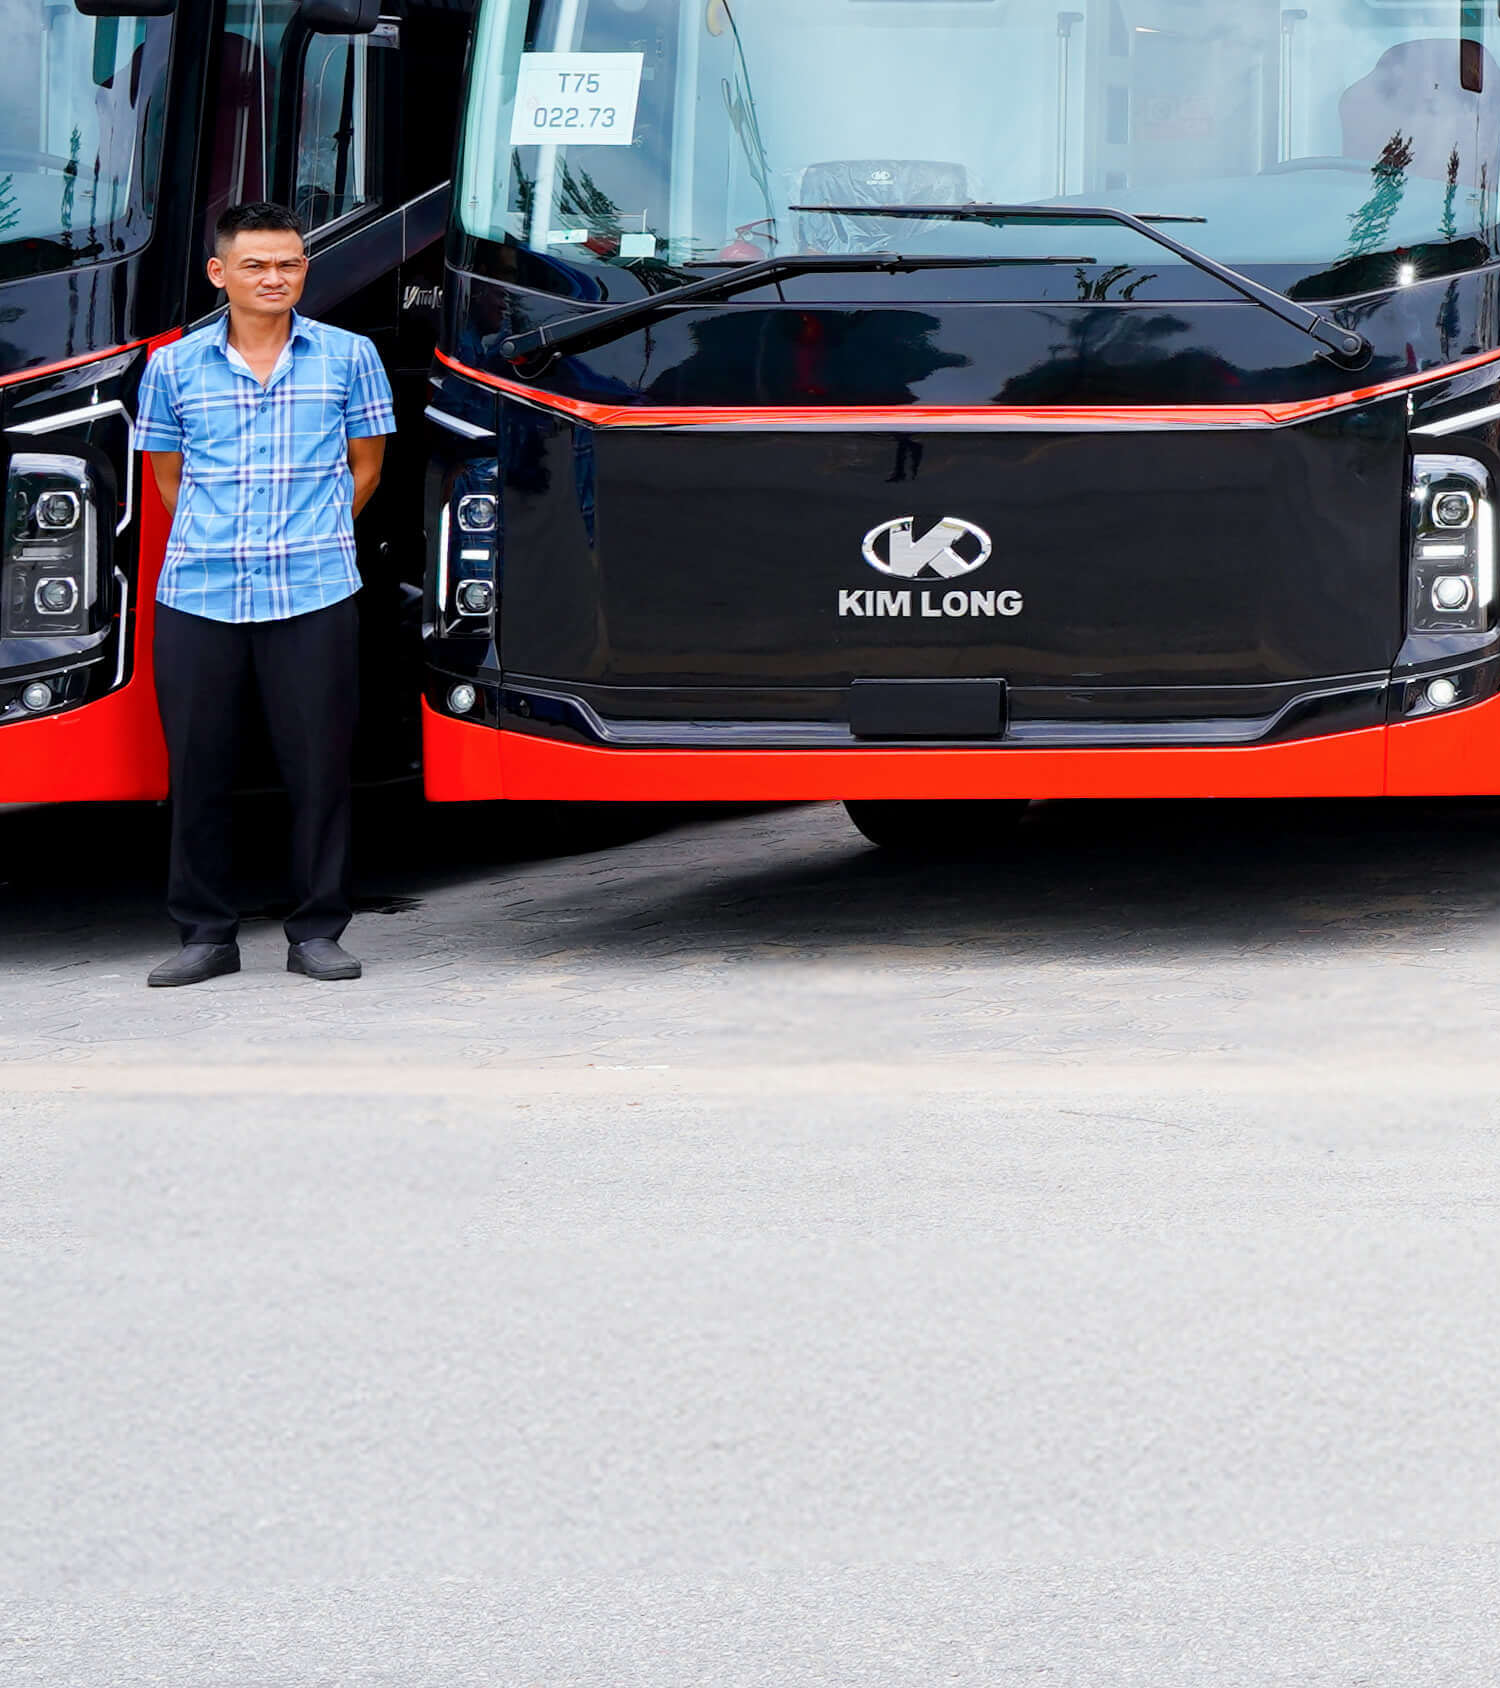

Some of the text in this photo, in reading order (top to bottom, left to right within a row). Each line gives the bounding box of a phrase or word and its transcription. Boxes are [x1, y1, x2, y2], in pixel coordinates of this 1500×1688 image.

[558, 73, 600, 93] T75
[533, 107, 616, 128] 022.73
[838, 589, 1023, 617] KIM LONG
